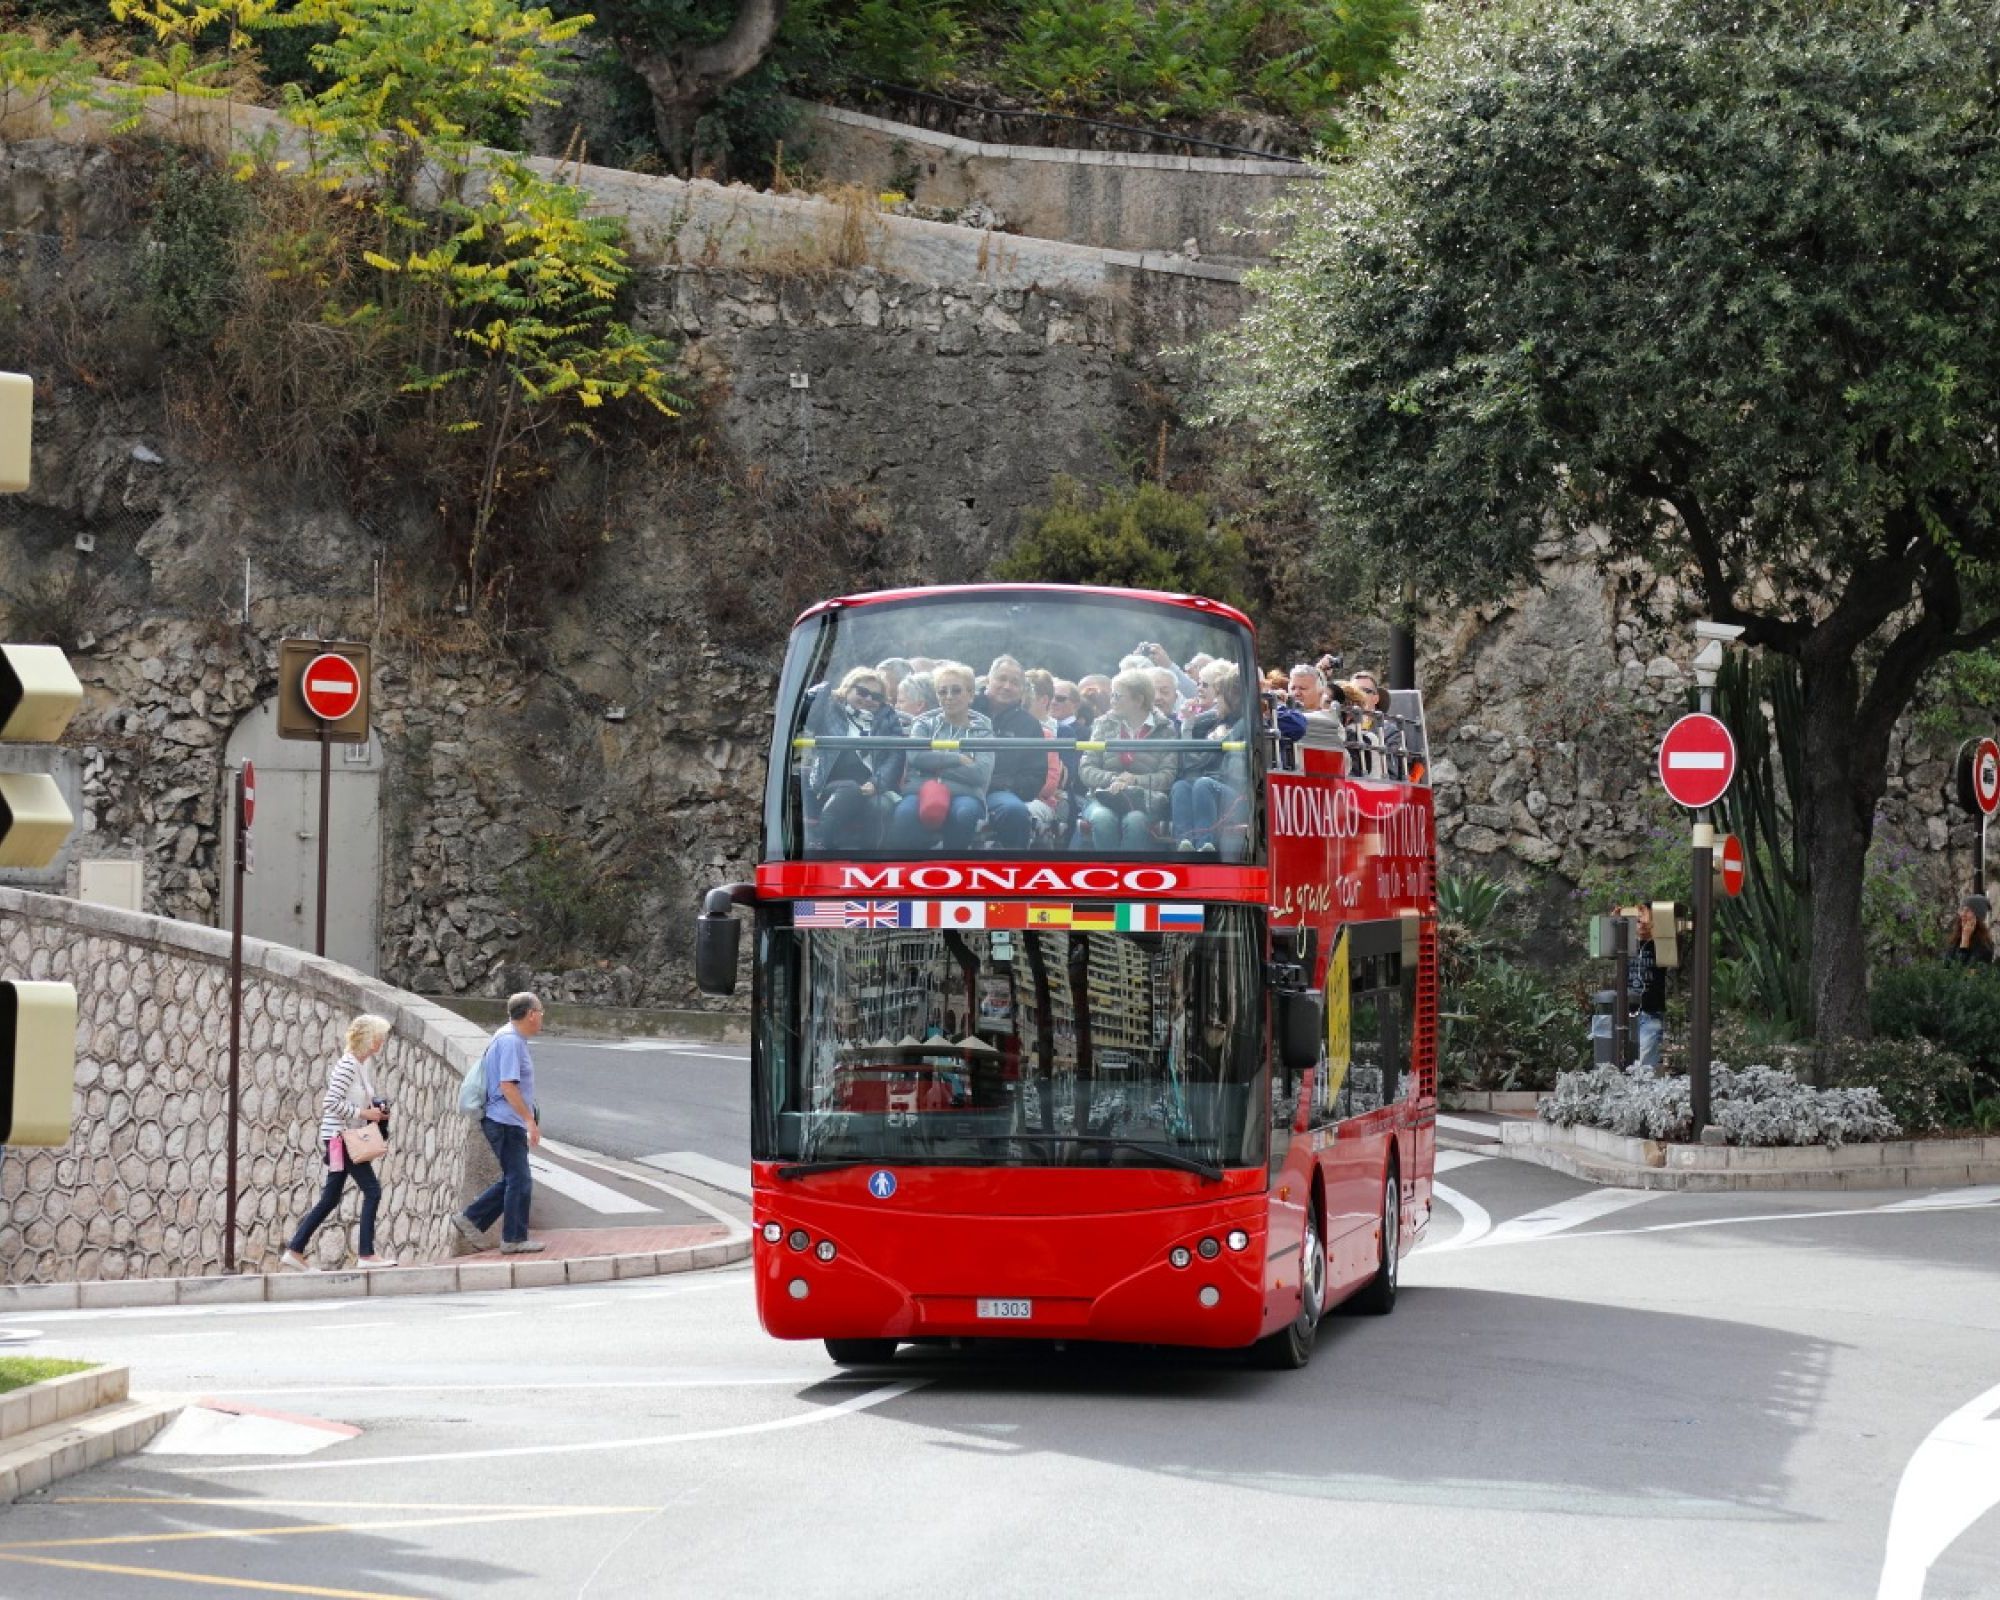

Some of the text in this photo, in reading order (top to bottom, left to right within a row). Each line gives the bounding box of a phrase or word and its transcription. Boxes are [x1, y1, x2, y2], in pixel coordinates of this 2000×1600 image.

[1272, 784, 1359, 838] MONACO
[839, 867, 1178, 891] MONACO
[993, 1302, 1029, 1316] 1303
